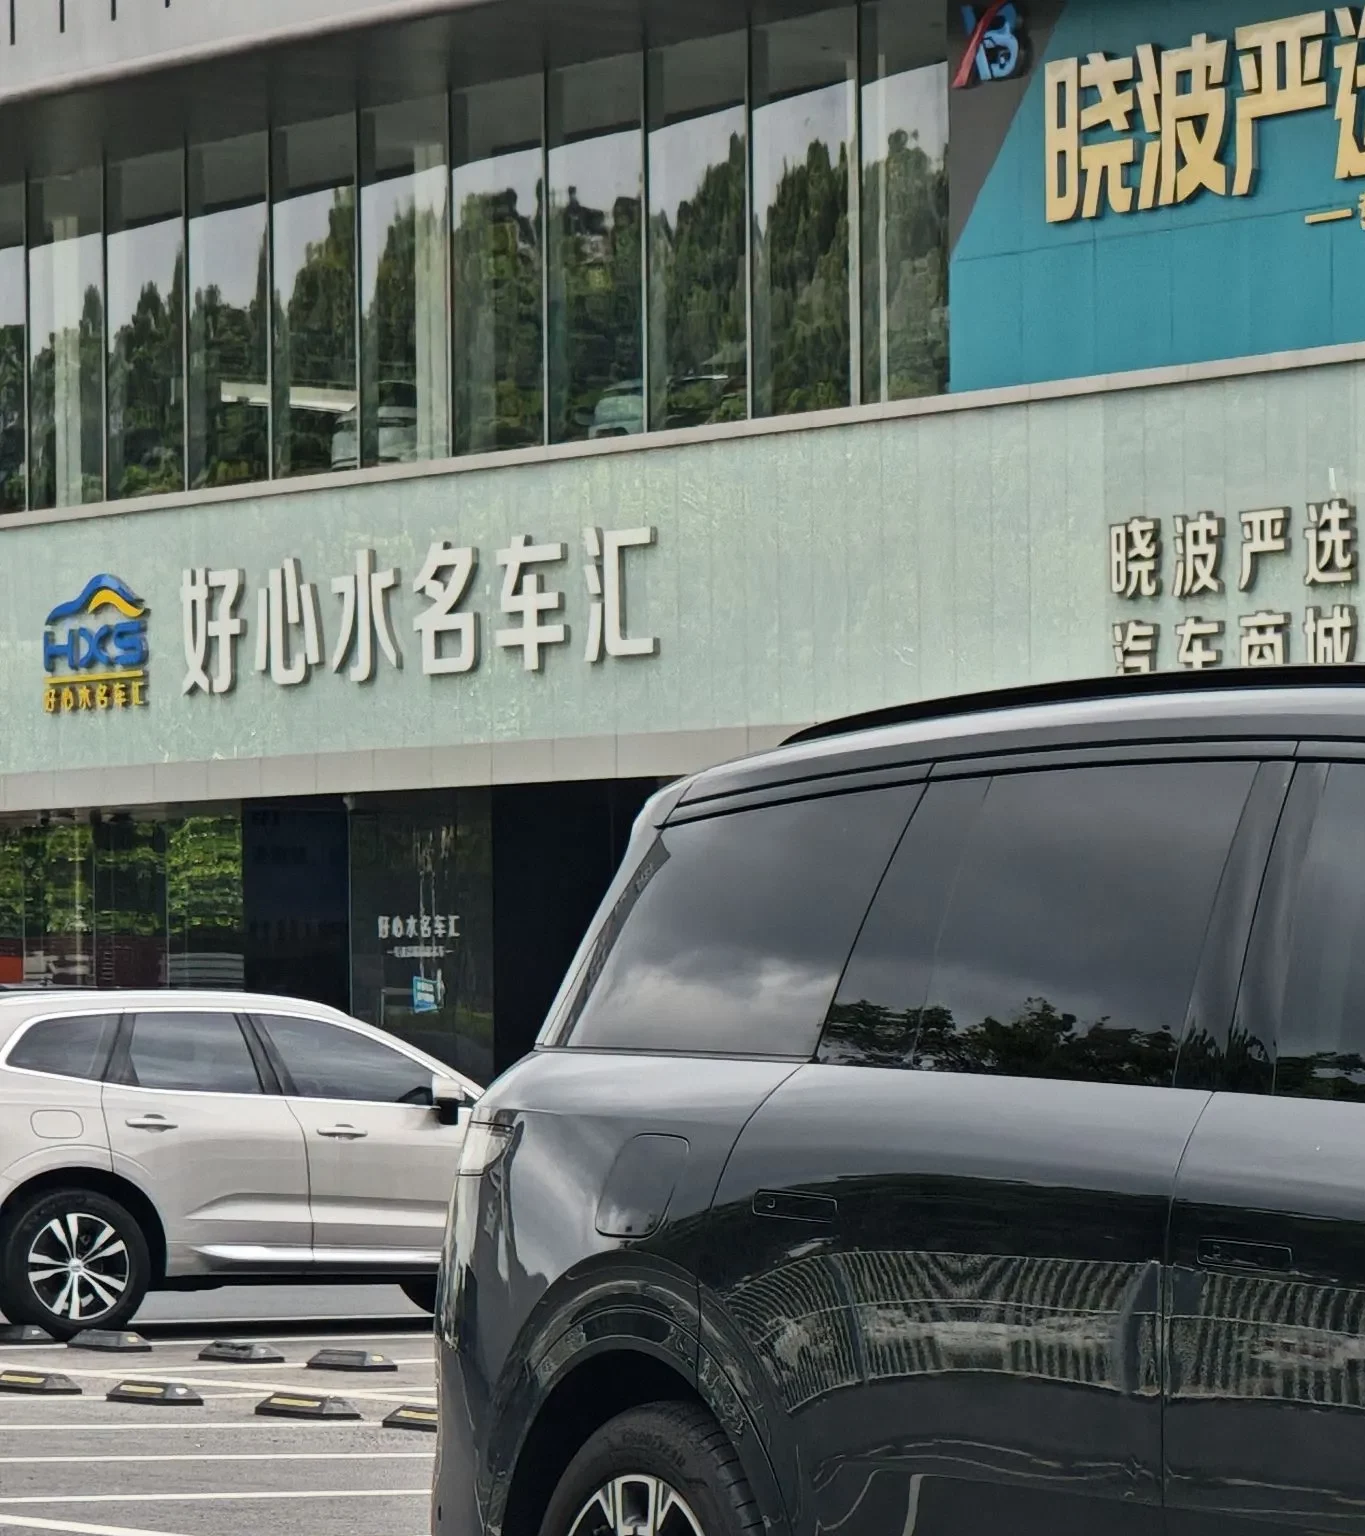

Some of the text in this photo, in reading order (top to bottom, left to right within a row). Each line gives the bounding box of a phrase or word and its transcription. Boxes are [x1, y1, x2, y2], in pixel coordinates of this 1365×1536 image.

[1109, 498, 1358, 598] 晓波严选
[180, 526, 660, 697] 好心水名车汇
[1112, 604, 1358, 675] 汽车商城
